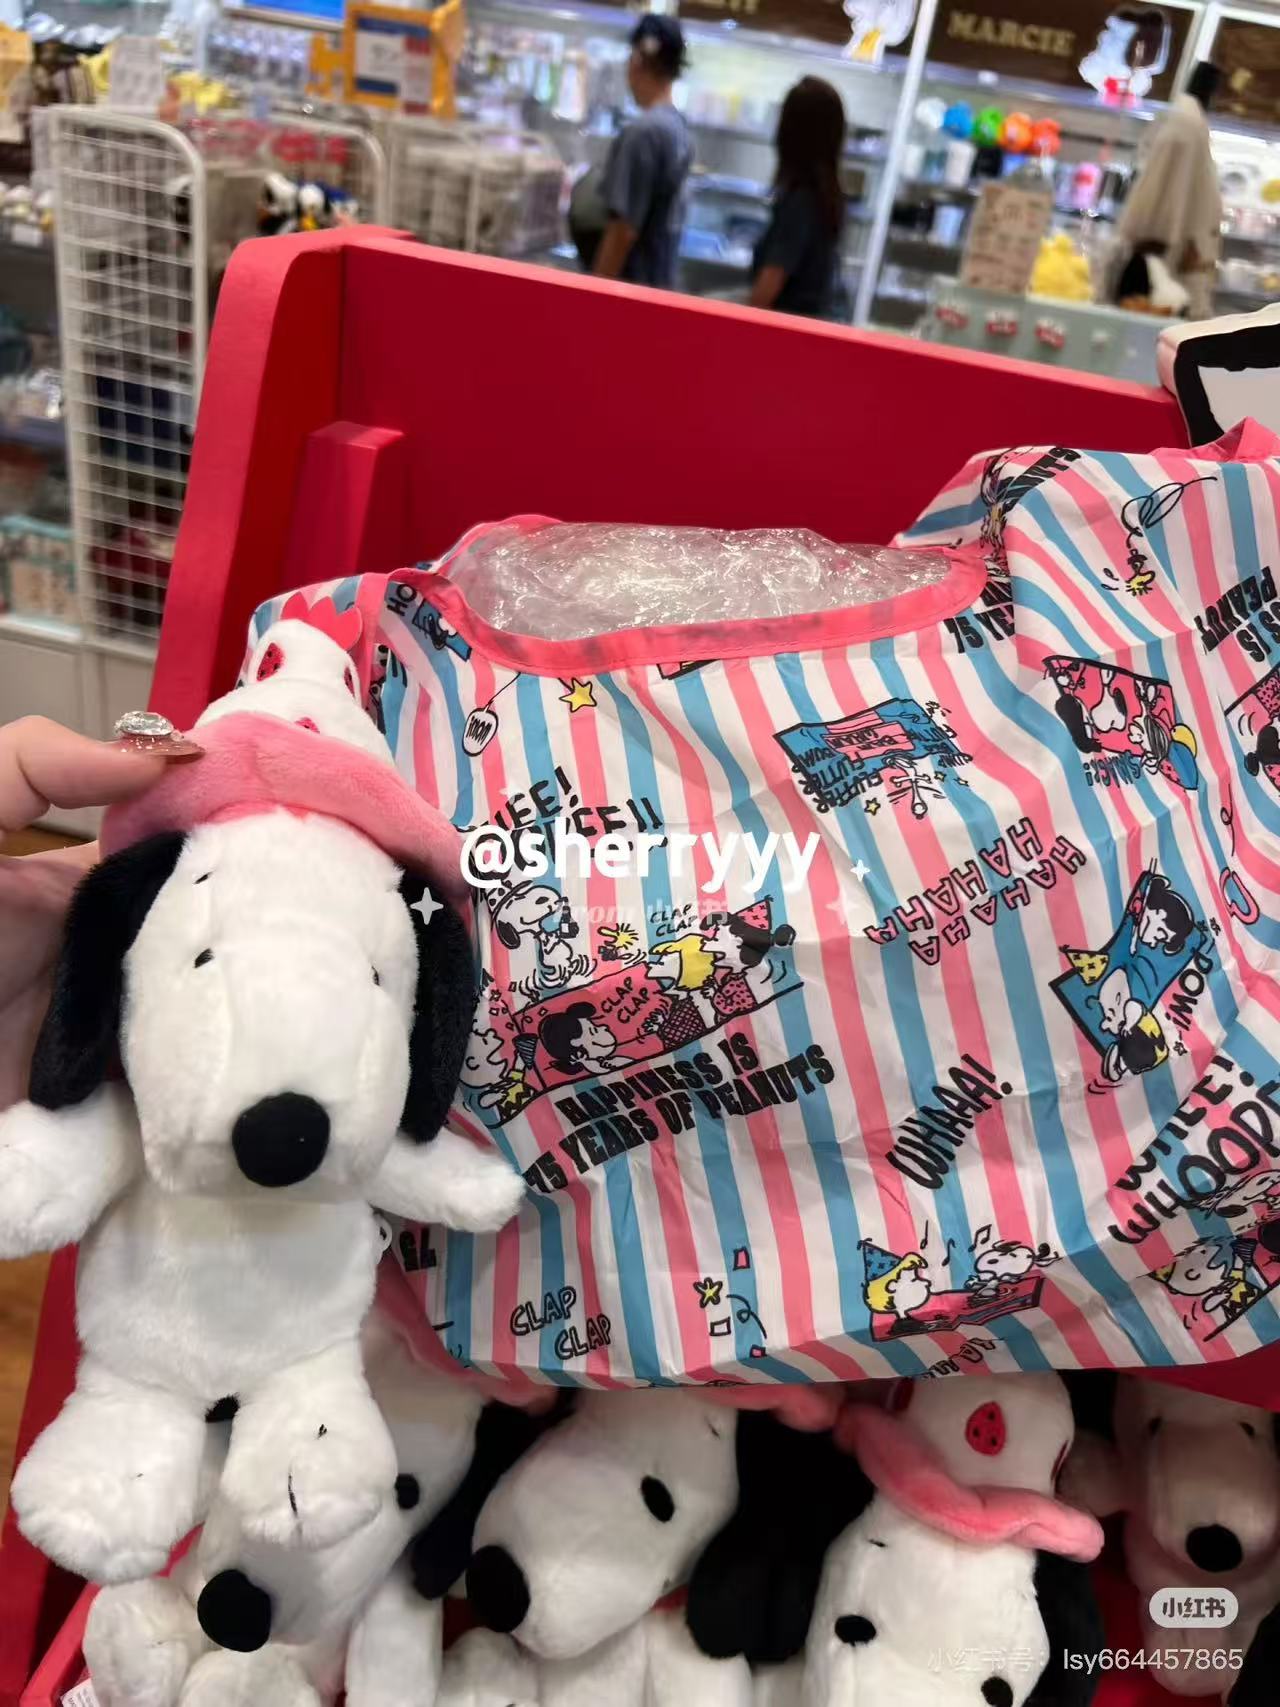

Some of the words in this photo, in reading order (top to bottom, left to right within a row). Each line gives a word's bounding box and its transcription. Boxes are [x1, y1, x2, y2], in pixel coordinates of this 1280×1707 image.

[947, 11, 1075, 55] MARCIE
[1194, 565, 1278, 653] PEANUT
[601, 976, 633, 1013] CLAP
[617, 987, 650, 1024] CLAP
[554, 1052, 723, 1126] HAPPINESS
[718, 1032, 759, 1076] IS
[559, 1108, 659, 1174] YEARS
[655, 1091, 696, 1135] OF
[696, 1044, 835, 1119] PEANUTS
[886, 1053, 1013, 1189] WHAAA!
[510, 1285, 577, 1336] CLAP
[554, 1313, 612, 1360] CLAP
